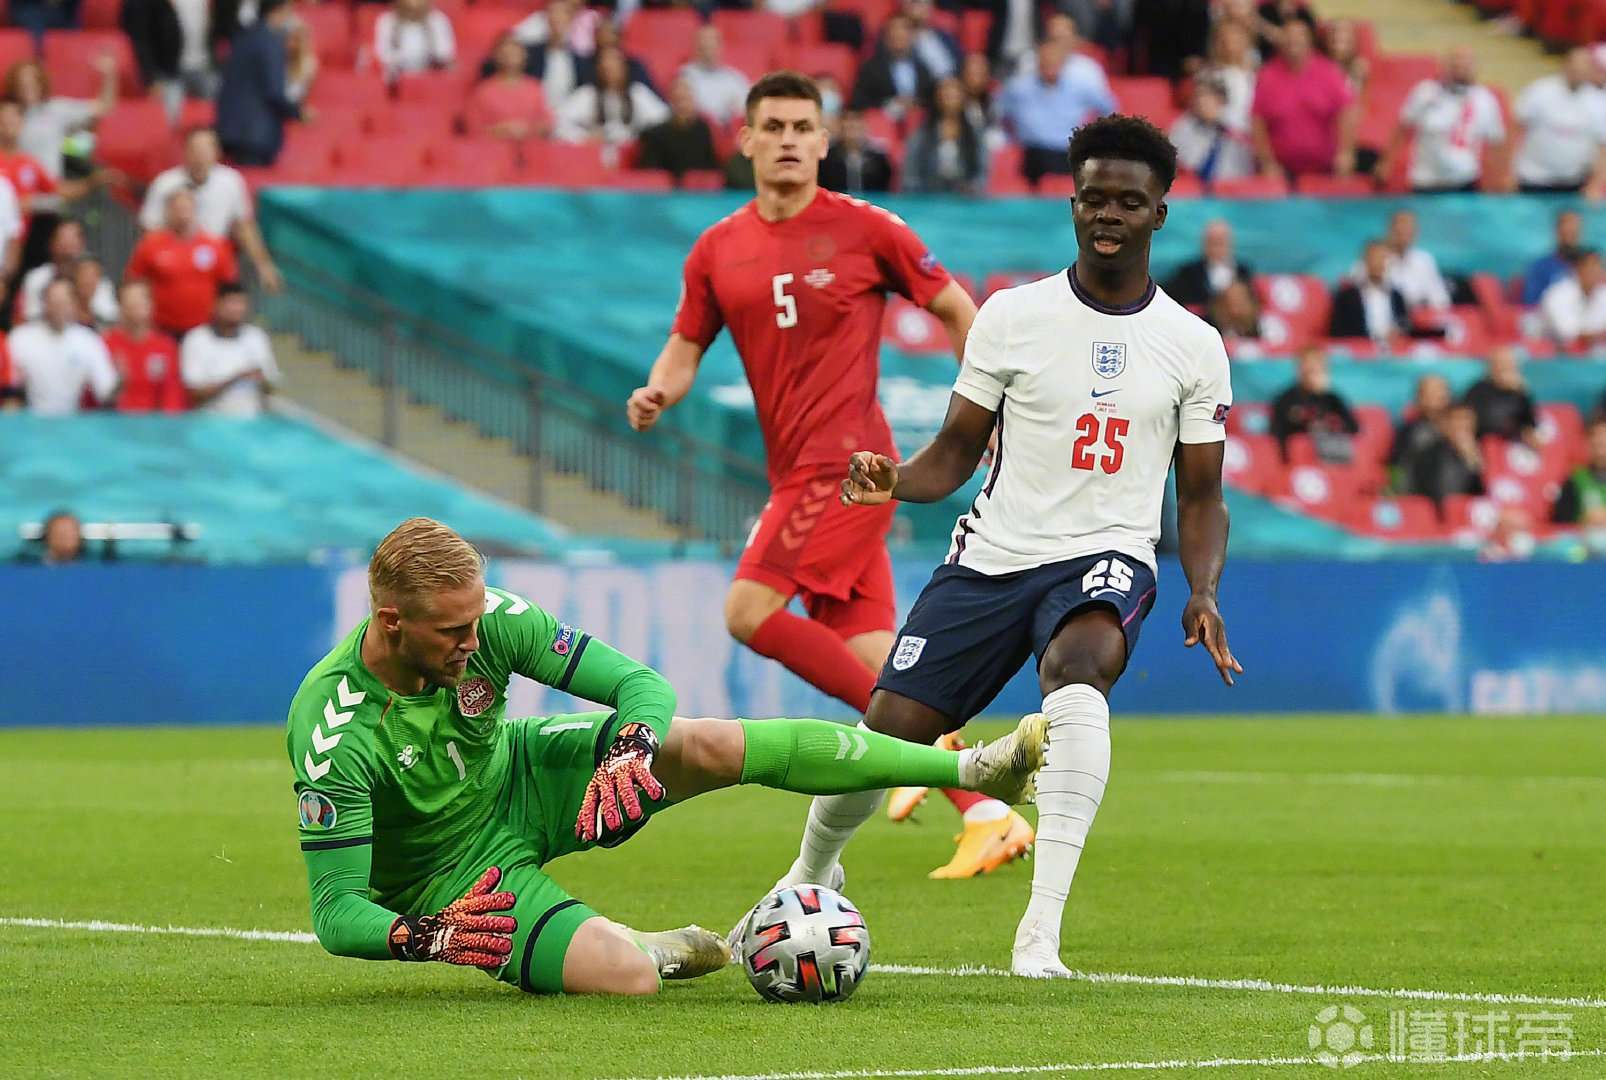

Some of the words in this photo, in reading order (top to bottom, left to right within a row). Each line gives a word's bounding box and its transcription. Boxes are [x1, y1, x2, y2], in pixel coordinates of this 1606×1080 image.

[772, 272, 798, 329] 5
[1071, 412, 1131, 475] 25
[1082, 557, 1134, 593] 25
[462, 684, 487, 707] DBU
[539, 721, 594, 736] 1
[446, 740, 467, 781] 1
